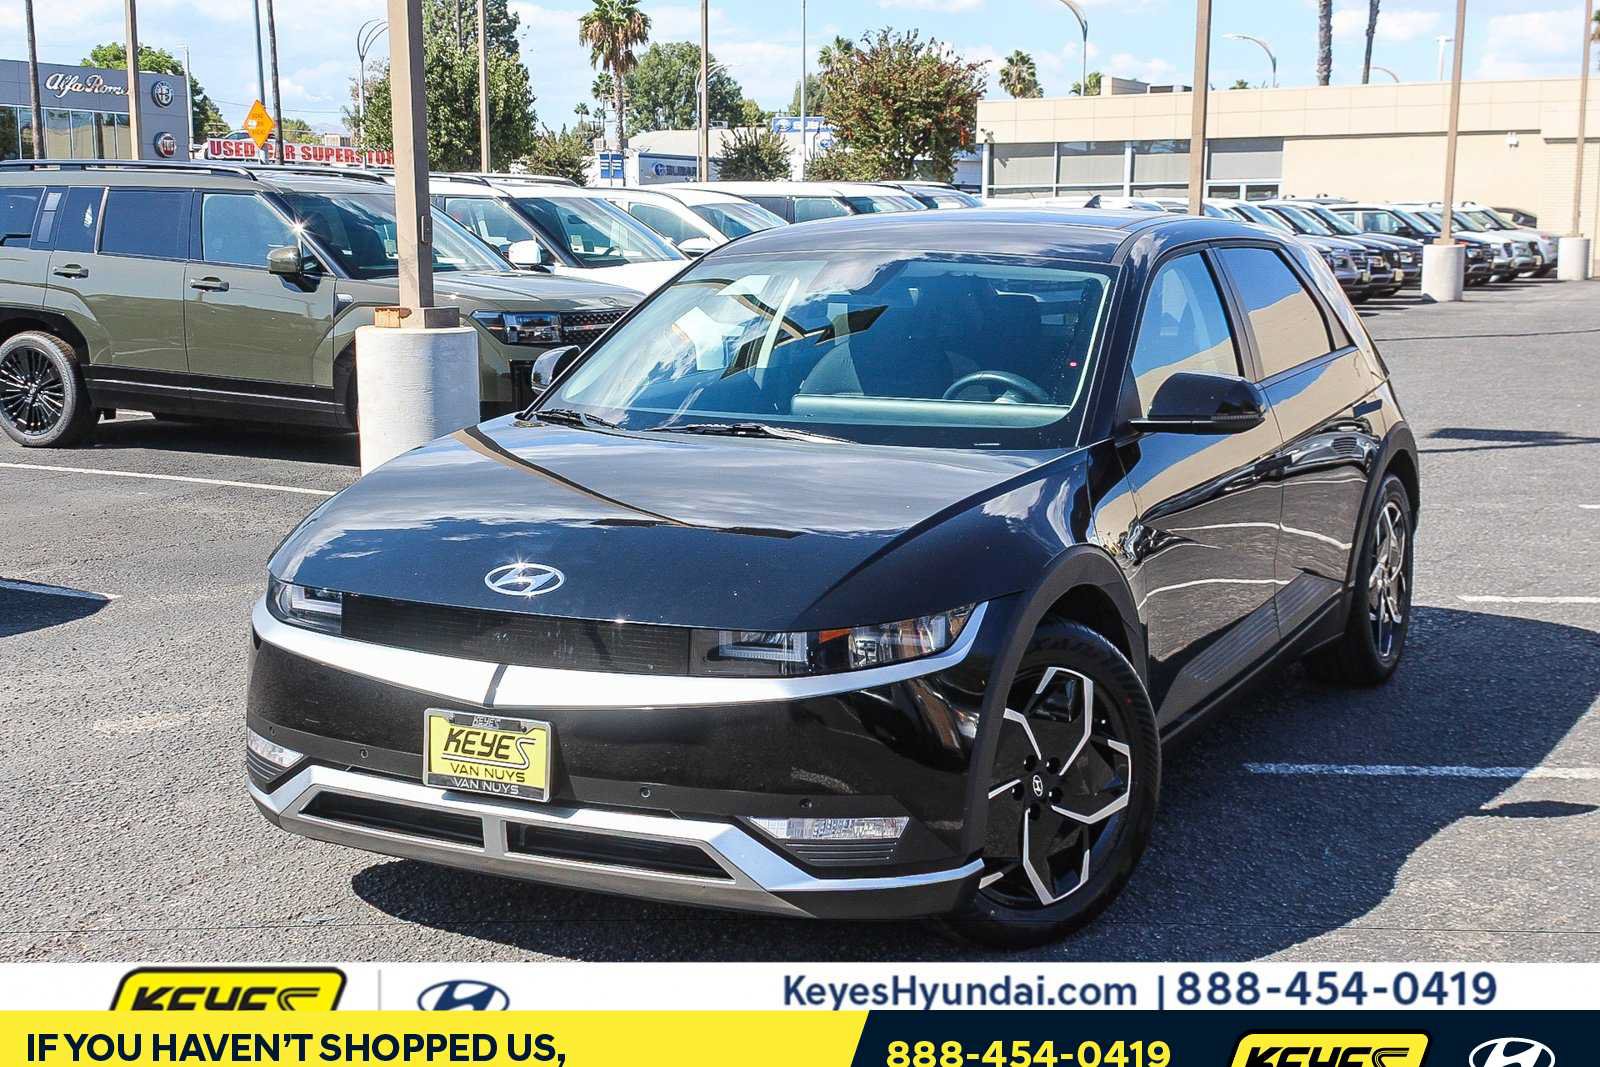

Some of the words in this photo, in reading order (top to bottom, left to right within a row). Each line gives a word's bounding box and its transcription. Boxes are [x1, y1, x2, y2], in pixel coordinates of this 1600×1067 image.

[45, 73, 84, 98] Alfa
[85, 74, 130, 96] Rome
[210, 140, 256, 157] USED
[266, 143, 296, 159] CR
[301, 145, 394, 165] SUPERSTOR
[472, 716, 501, 729] KEYES
[442, 727, 537, 770] KEYES
[450, 762, 479, 776] VAN
[484, 767, 525, 783] NUYS
[453, 777, 479, 789] VAN
[482, 781, 519, 795] NUYS
